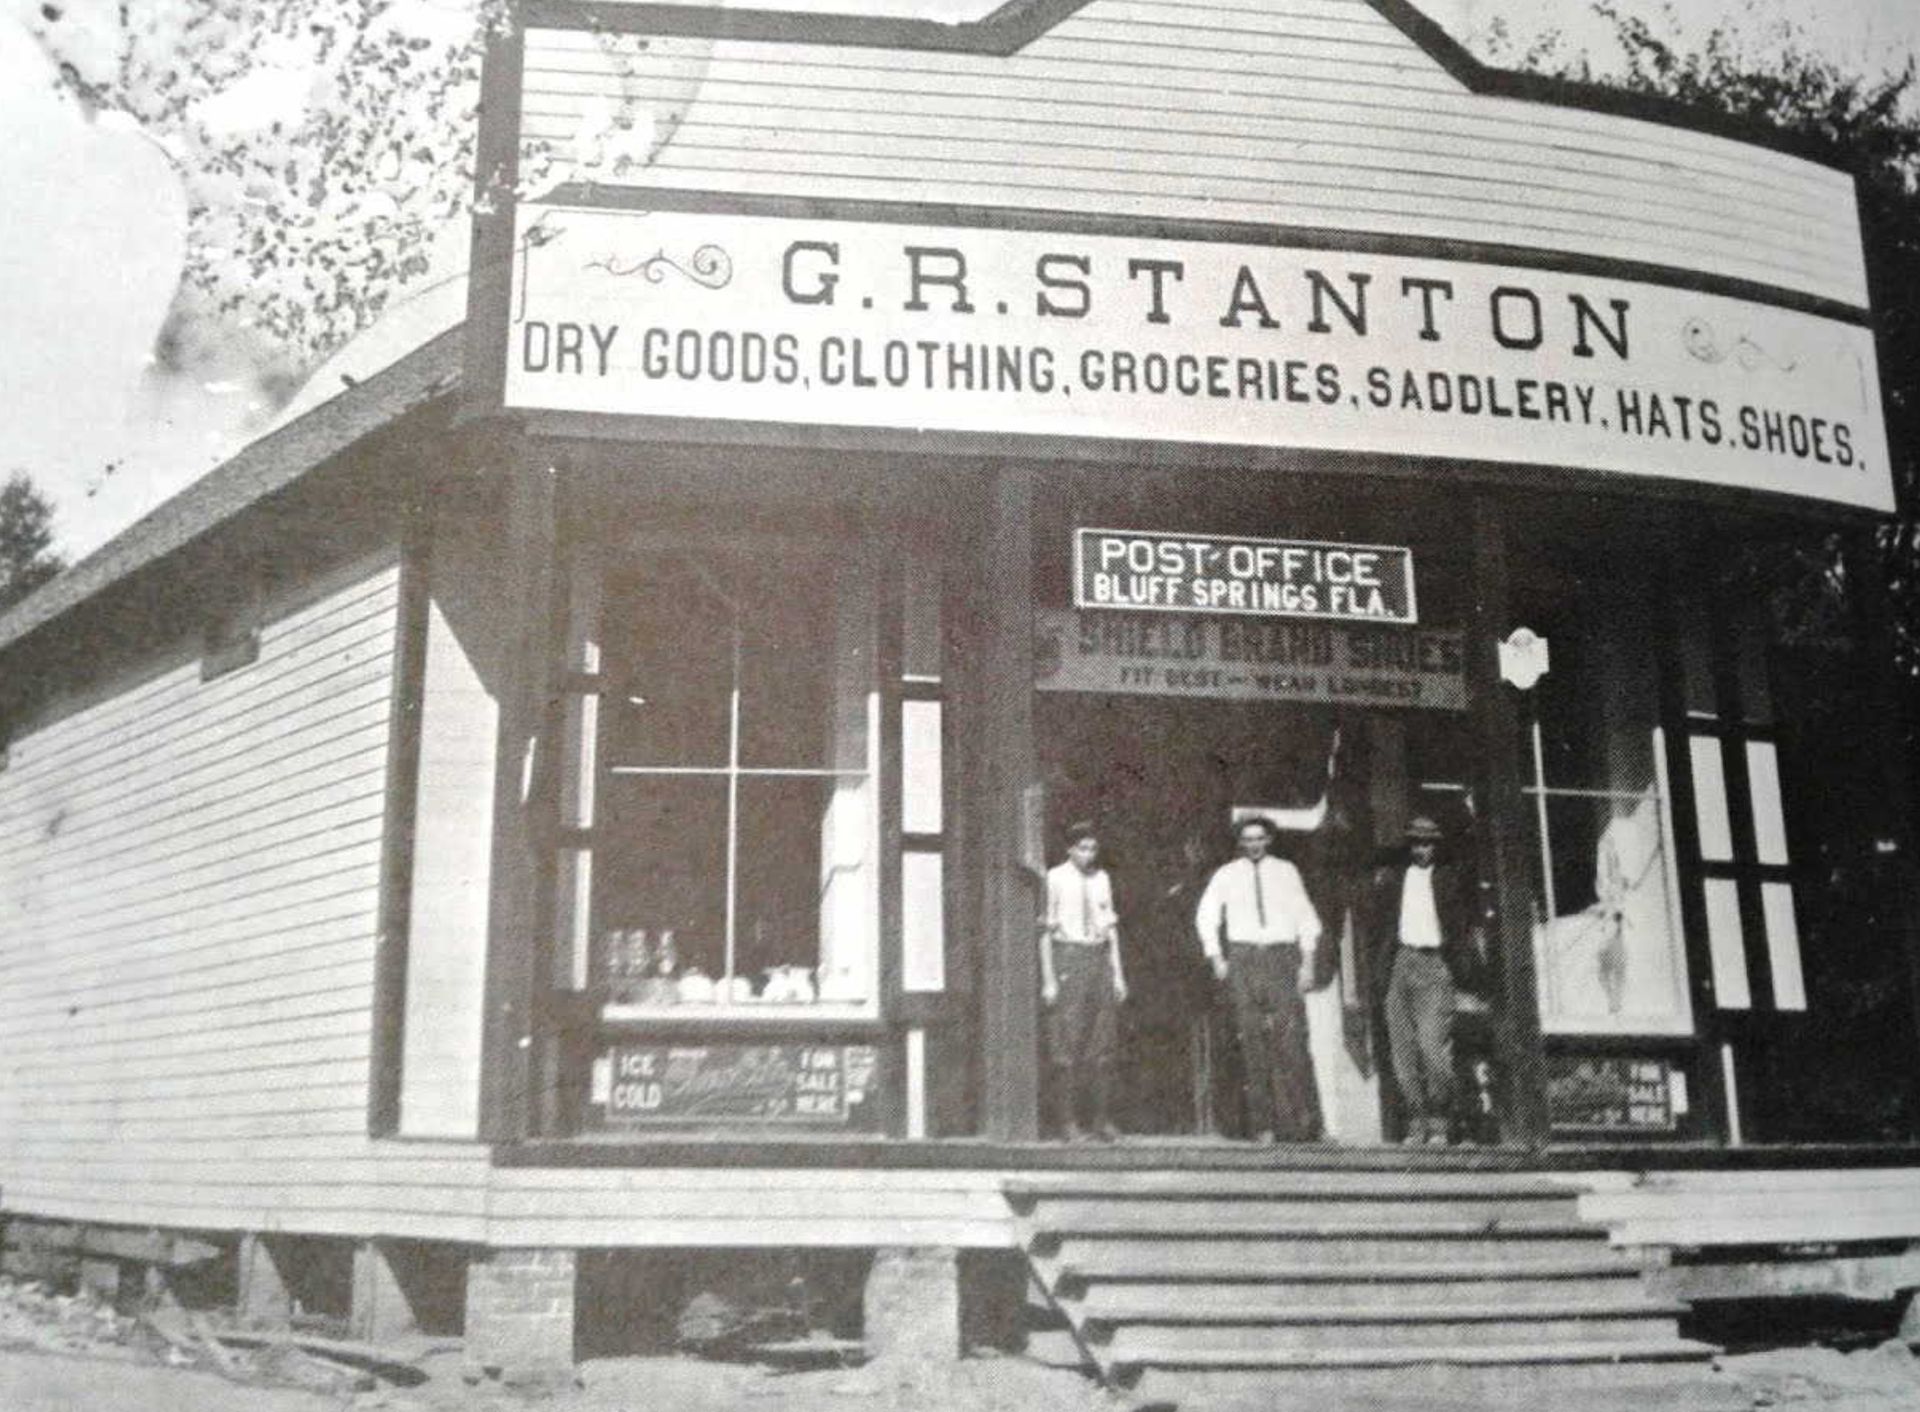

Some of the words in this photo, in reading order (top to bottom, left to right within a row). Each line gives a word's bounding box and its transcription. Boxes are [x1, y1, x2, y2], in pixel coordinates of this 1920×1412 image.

[522, 322, 619, 377] DRY
[1093, 572, 1184, 605] BLUFF
[1191, 577, 1318, 612] SPRINGS
[1329, 584, 1396, 617] FLA.
